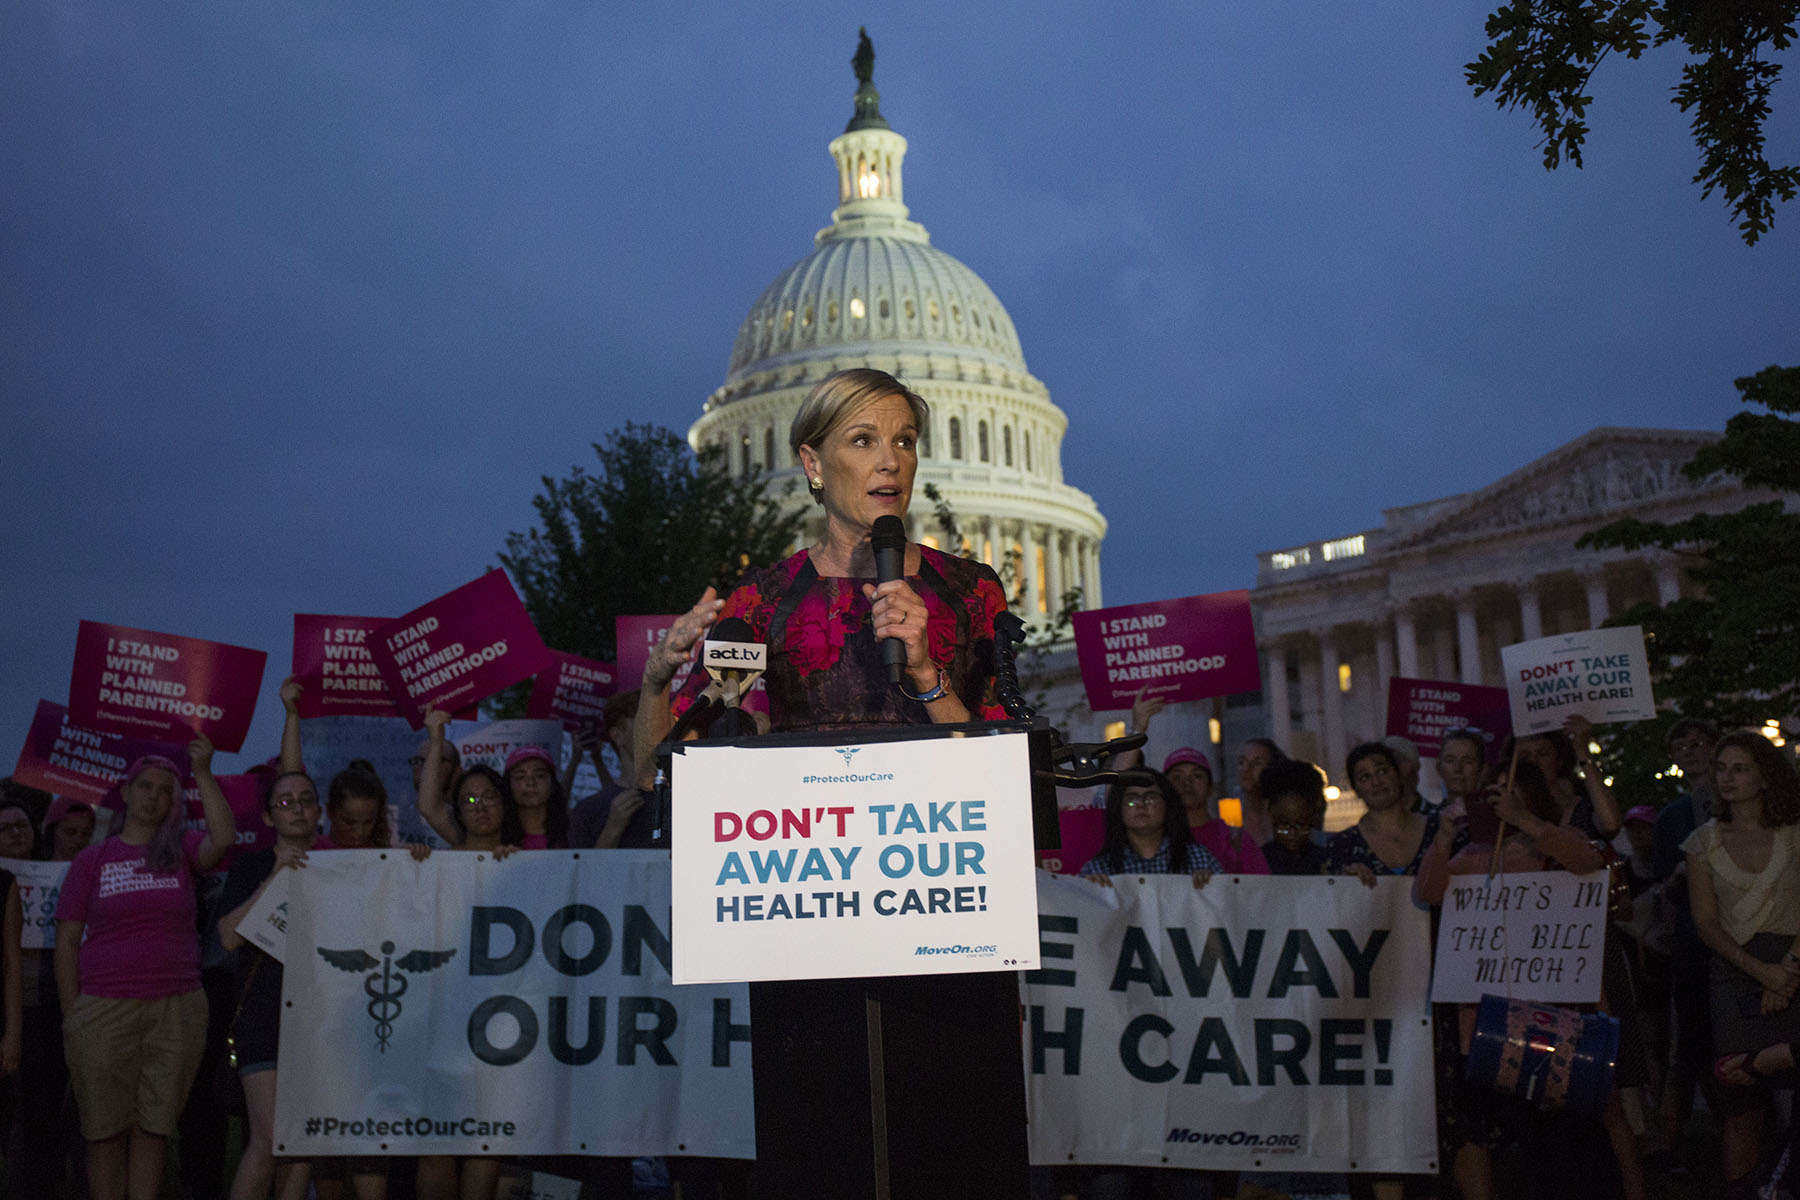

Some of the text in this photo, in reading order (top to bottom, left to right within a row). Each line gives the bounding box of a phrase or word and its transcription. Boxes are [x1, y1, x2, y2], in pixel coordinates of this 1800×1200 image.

[324, 627, 373, 643] I STA
[386, 616, 439, 652] I STAND
[1100, 614, 1167, 635] I STAND
[108, 638, 179, 661] I STAND
[324, 645, 372, 660] WITH
[394, 639, 430, 667] WITH
[1103, 632, 1149, 650] WITH
[106, 654, 154, 675] WITH
[400, 642, 464, 683] PLANNED
[710, 648, 760, 660] act.tv
[1105, 644, 1185, 667] PLANNED
[407, 641, 508, 698] PARENTHOOD
[568, 664, 612, 684] STAND
[1107, 655, 1226, 683] PARENTHOOD
[1520, 654, 1630, 682] DON'T TAKE
[101, 671, 186, 697] PLANNED
[1418, 688, 1461, 702] STAND
[1525, 671, 1631, 697] AWAY OUR
[98, 688, 223, 721] PARENTHOOD
[1410, 700, 1446, 713] WITH
[1526, 687, 1634, 712] HEALTH CARE!
[61, 725, 102, 747] WITH
[54, 738, 127, 769] PLANNED
[463, 743, 509, 755] DON'T
[803, 773, 894, 784] #ProtectOurCare
[714, 800, 987, 842] DON'T TAKE
[715, 841, 987, 886] AWAY OUR
[716, 886, 987, 923] HEALTH CARE!
[1573, 882, 1603, 908] IN
[1452, 924, 1592, 950] THE BILL
[1109, 925, 1391, 998] AWAY
[467, 994, 678, 1066] OUR
[1119, 1013, 1393, 1086] CARE!
[305, 1117, 516, 1136] #ProtectOurCare
[1166, 1128, 1300, 1146] MoveOn.ORG
